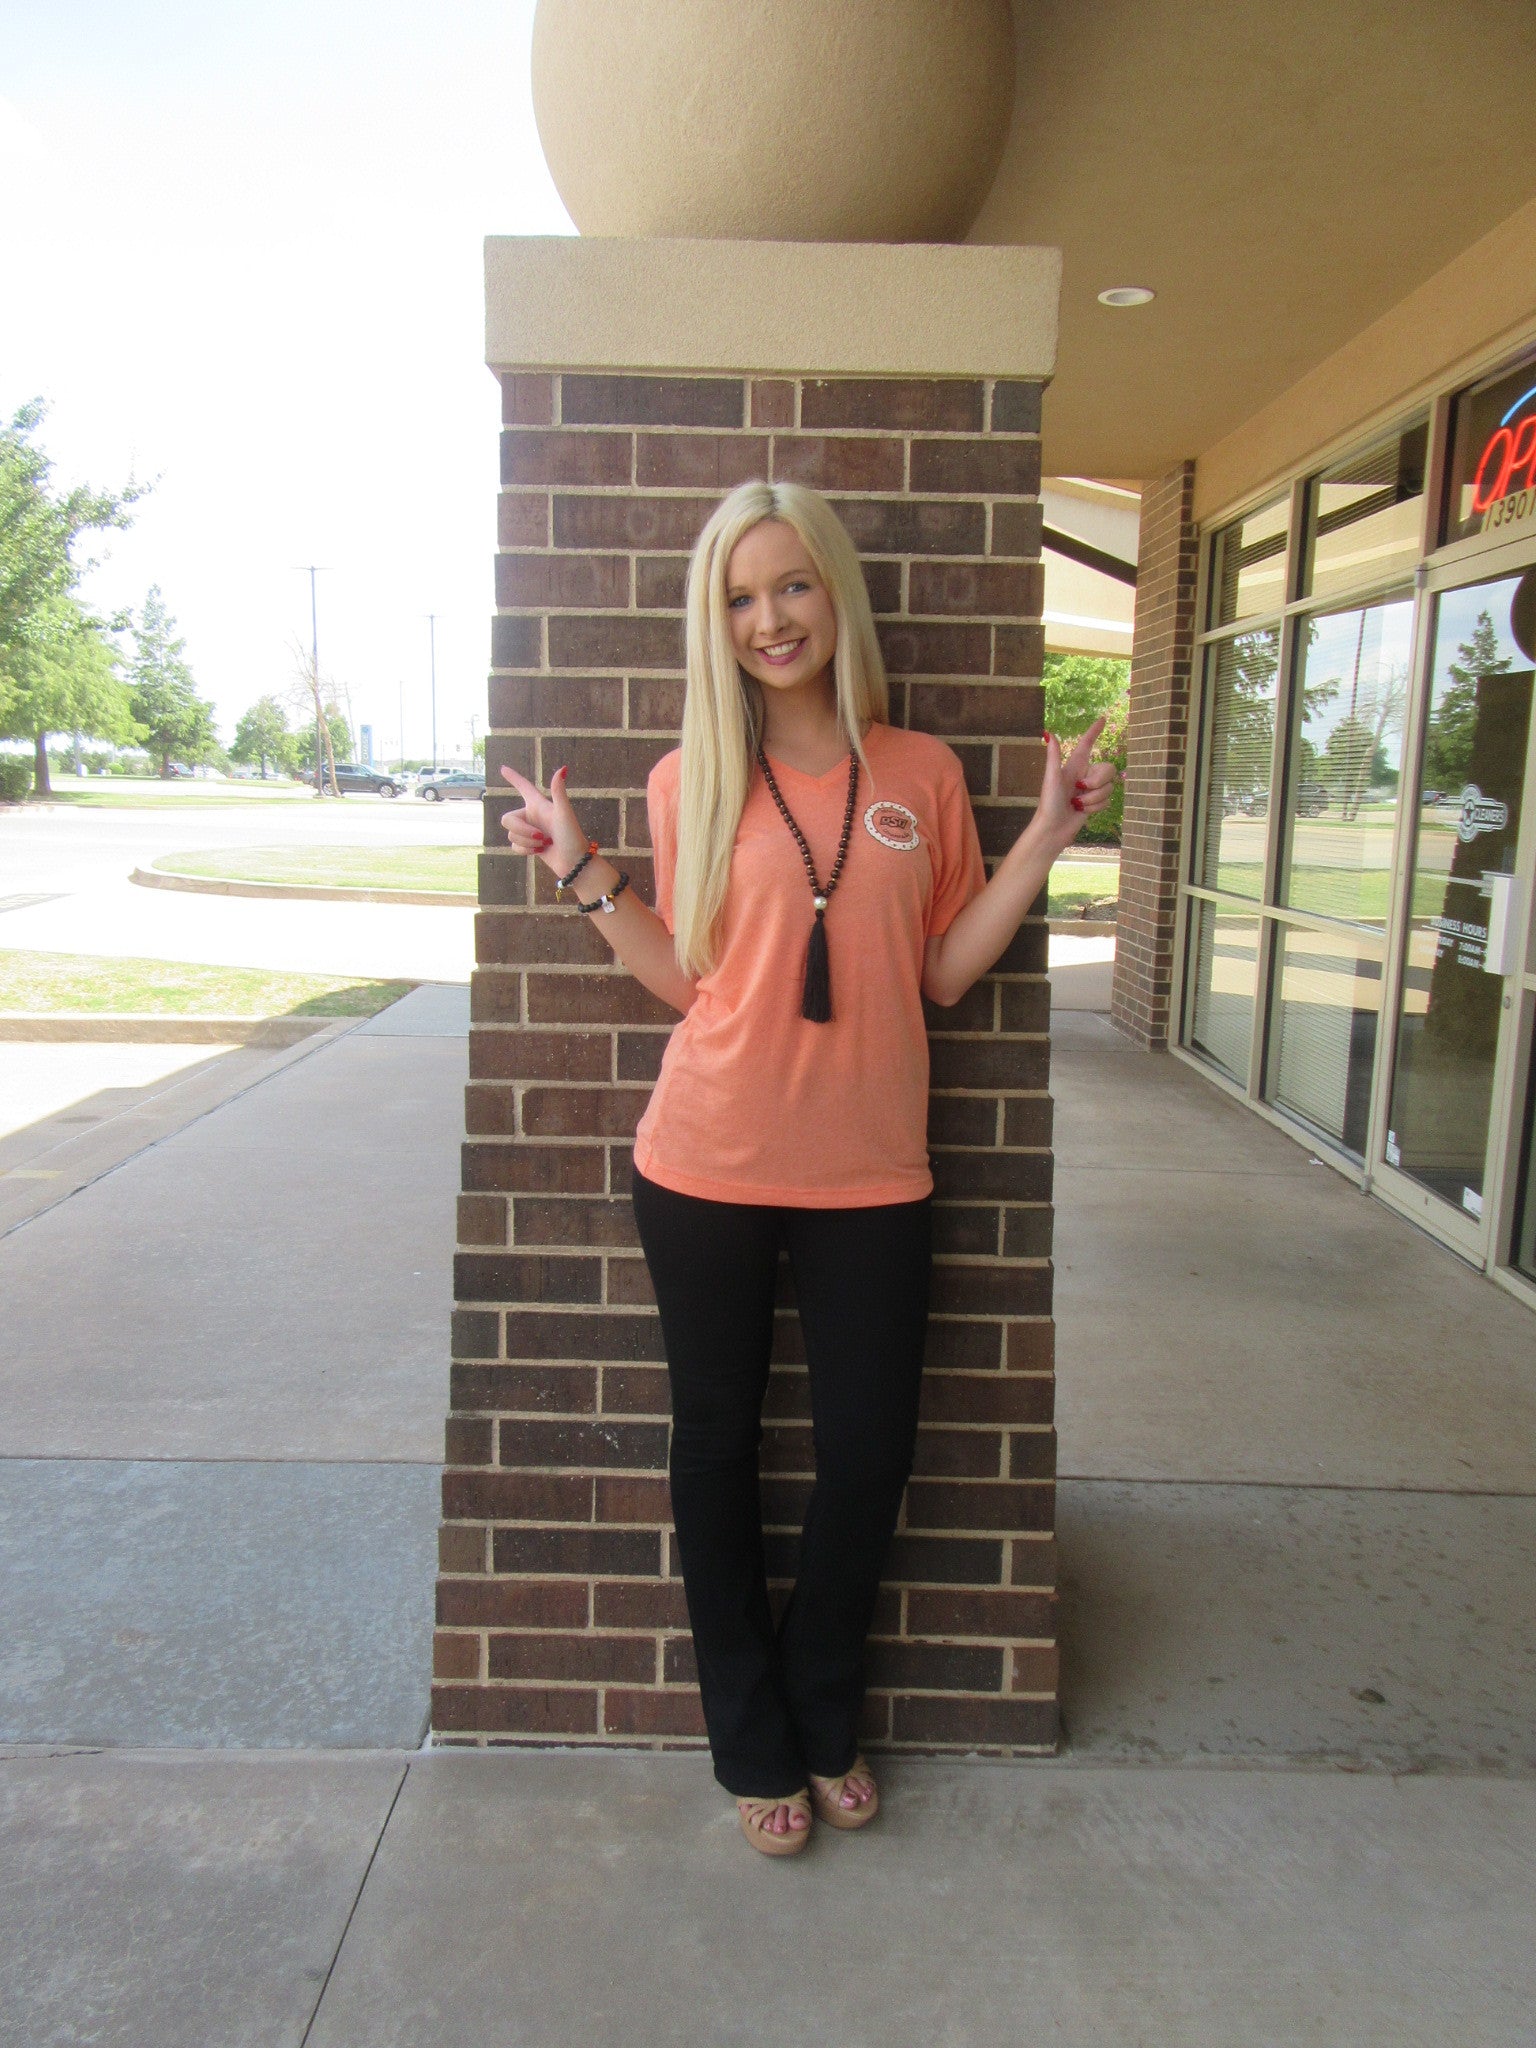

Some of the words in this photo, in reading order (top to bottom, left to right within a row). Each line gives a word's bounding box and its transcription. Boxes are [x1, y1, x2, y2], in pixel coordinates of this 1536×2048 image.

[1473, 413, 1536, 513] OP
[1474, 808, 1504, 823] CLEANERS
[1430, 917, 1461, 932] BUSINESS
[1462, 922, 1487, 939] HOURS
